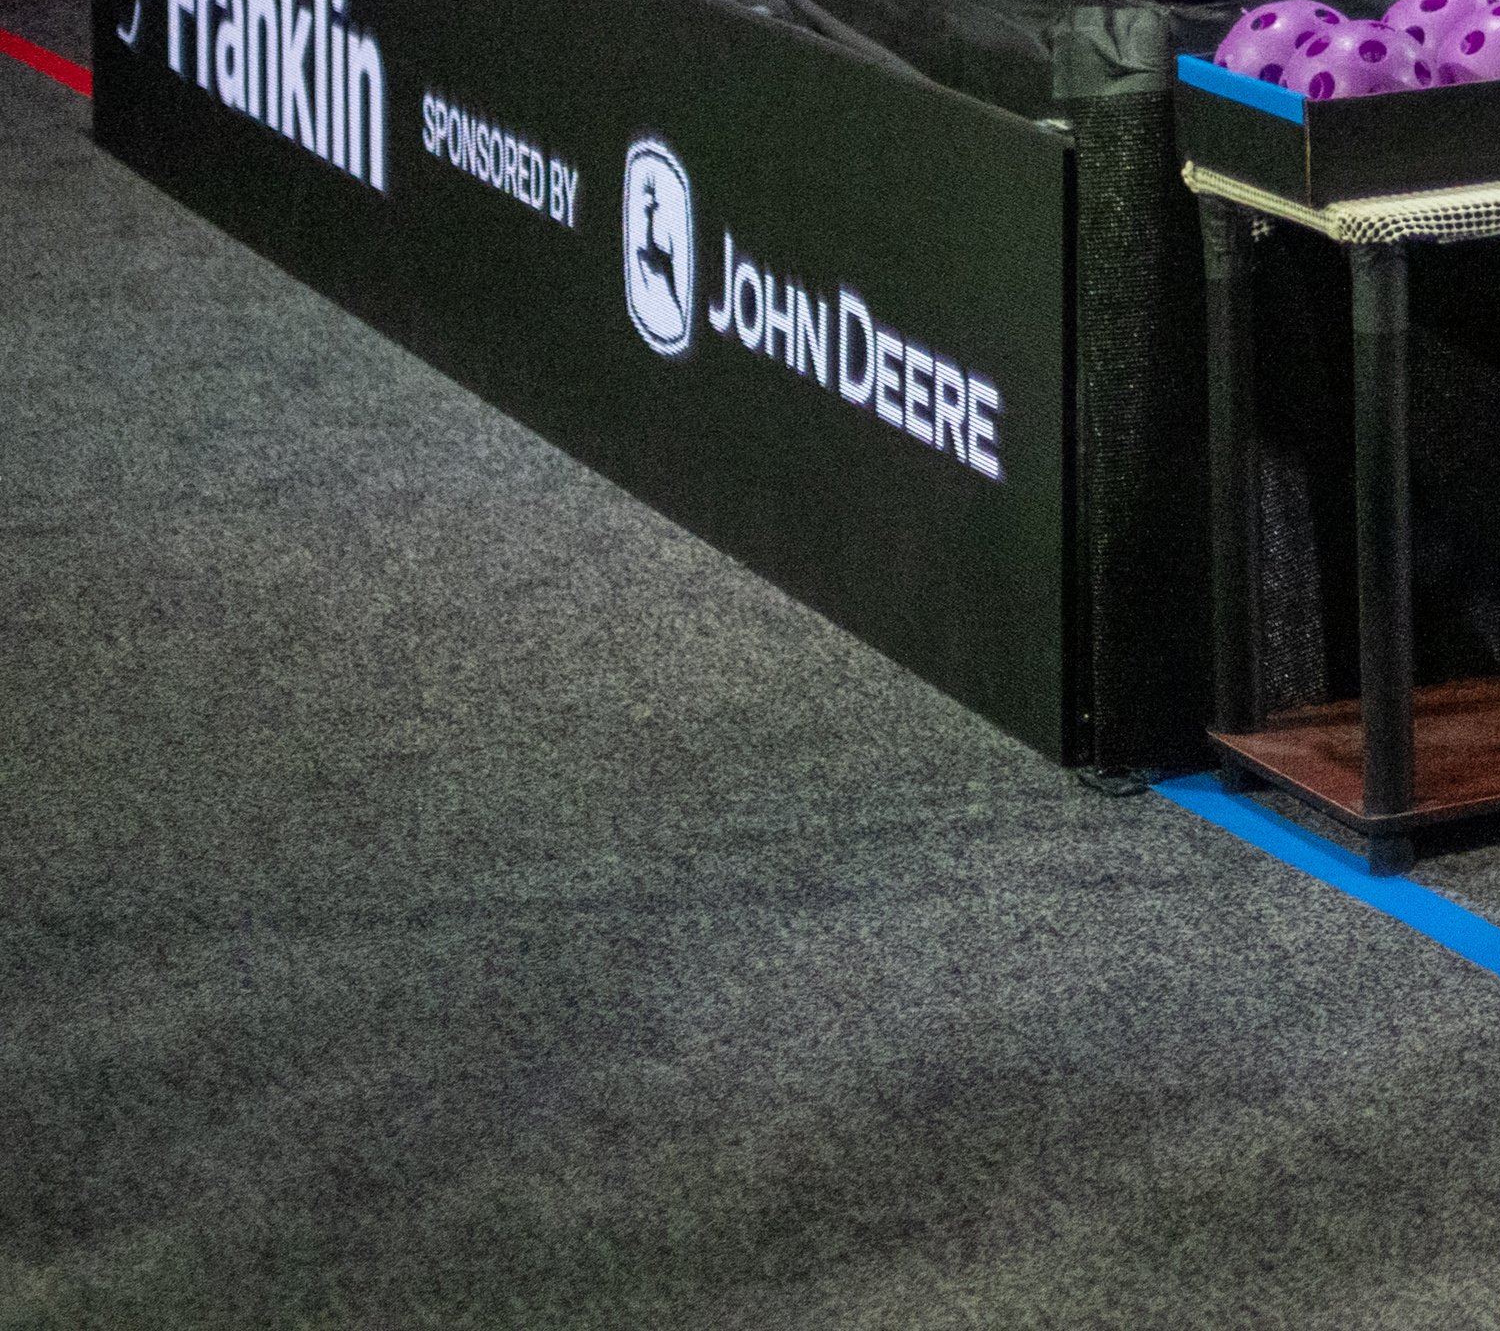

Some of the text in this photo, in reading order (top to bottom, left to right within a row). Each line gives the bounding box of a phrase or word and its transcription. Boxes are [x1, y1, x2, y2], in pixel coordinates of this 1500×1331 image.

[422, 92, 545, 211] SPONSORED
[550, 158, 578, 228] BY
[708, 230, 828, 388] JOHN
[838, 288, 1000, 481] DEERE
